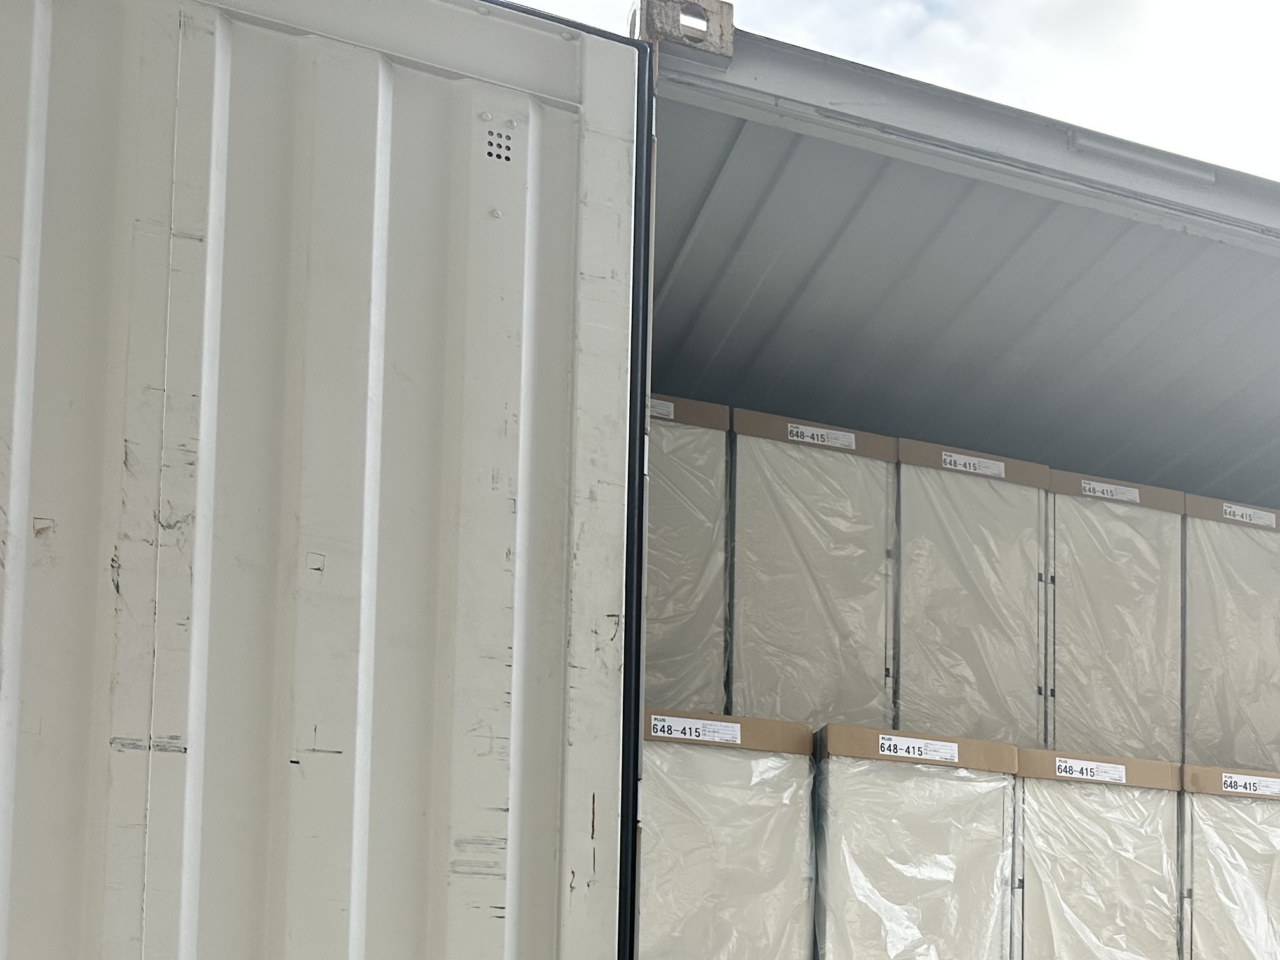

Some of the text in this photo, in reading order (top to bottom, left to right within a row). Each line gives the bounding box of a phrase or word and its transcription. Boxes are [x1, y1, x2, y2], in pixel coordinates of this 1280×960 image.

[789, 429, 826, 443] 648-415
[943, 458, 977, 472] 648-415
[1082, 485, 1115, 498] 648-415
[1223, 508, 1253, 522] 648-415
[652, 723, 701, 738] 648-415
[880, 742, 923, 757] 648-415
[1057, 764, 1095, 778] 648-415
[1223, 779, 1258, 792] 648-415
